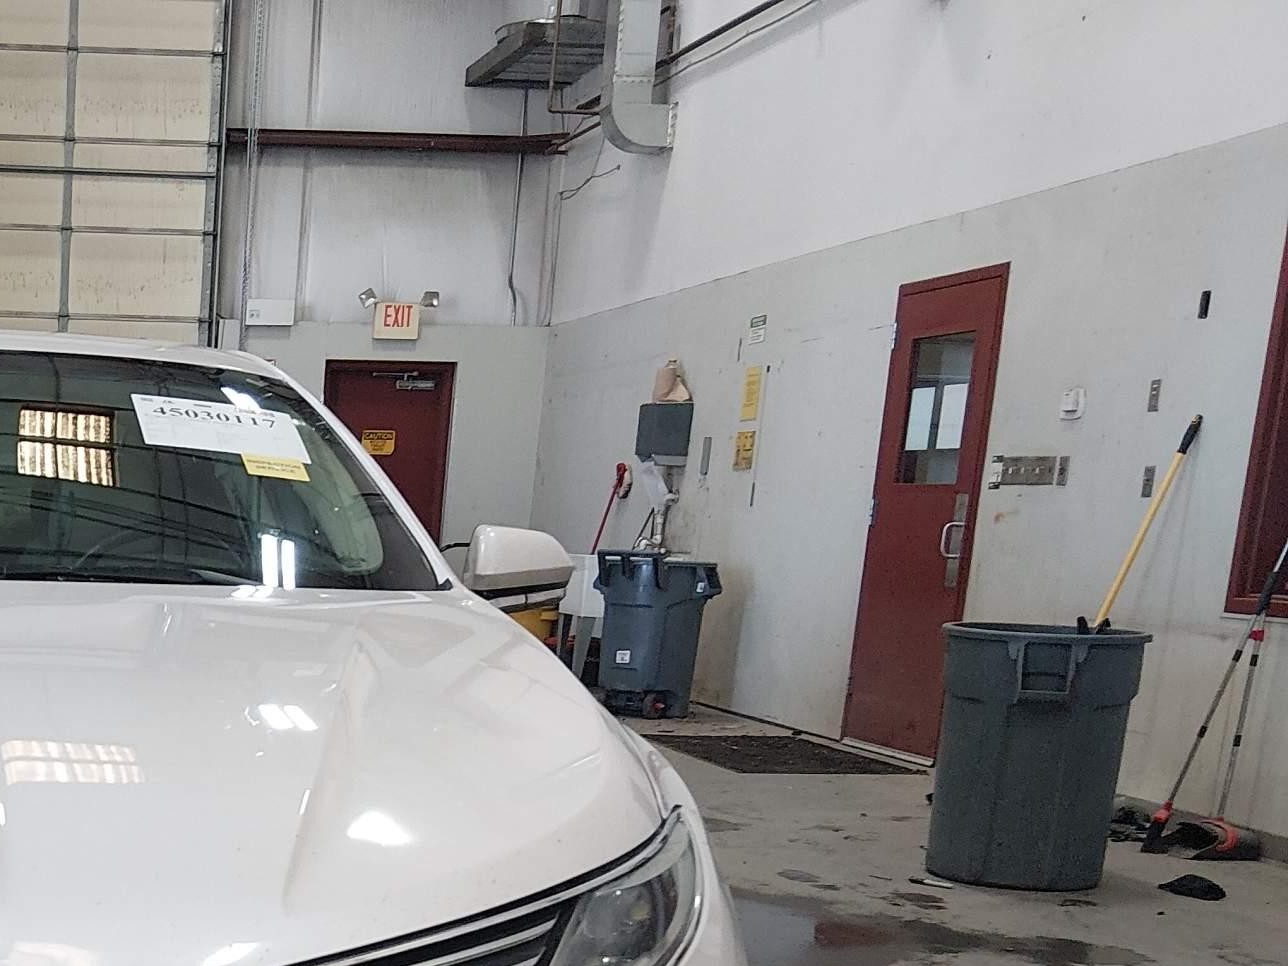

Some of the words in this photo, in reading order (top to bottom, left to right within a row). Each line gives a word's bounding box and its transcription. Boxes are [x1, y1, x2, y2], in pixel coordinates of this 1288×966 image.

[383, 304, 413, 327] EXIT
[153, 406, 276, 429] 45030117
[364, 432, 393, 440] CAUTION
